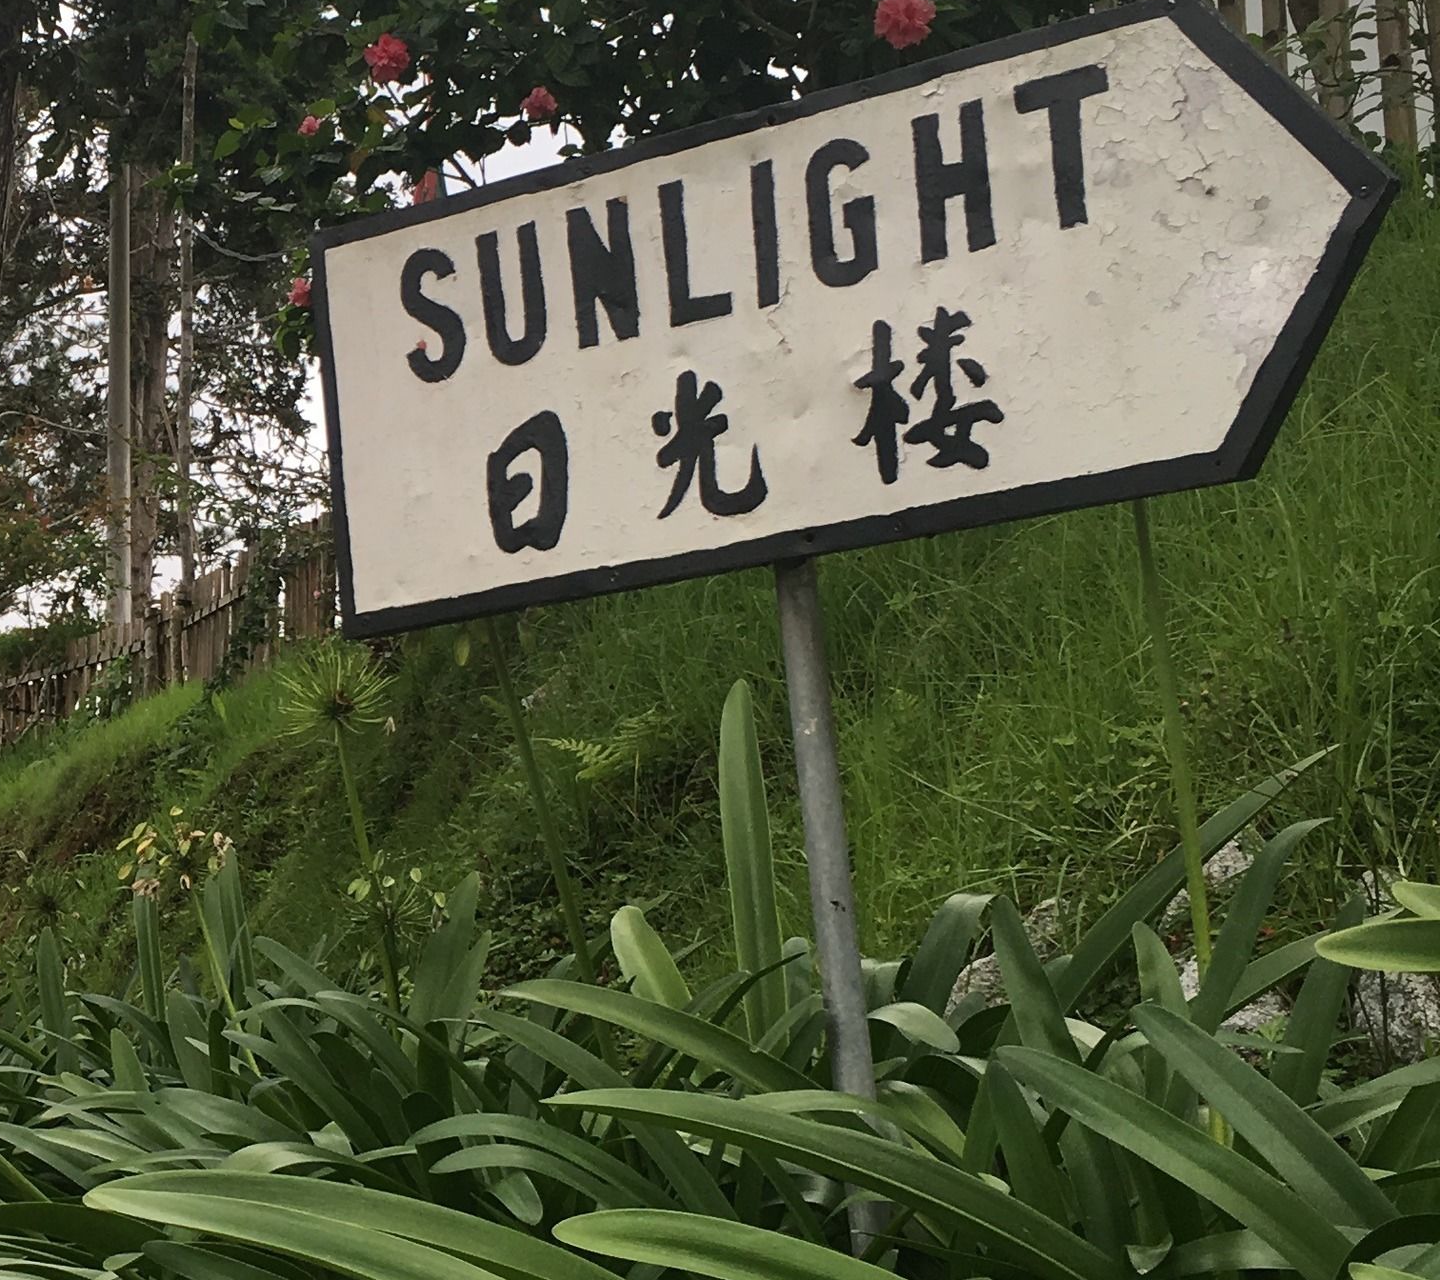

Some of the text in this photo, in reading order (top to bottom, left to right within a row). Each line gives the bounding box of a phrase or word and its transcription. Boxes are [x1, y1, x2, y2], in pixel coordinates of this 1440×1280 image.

[400, 64, 1108, 382] SUNLIGHT
[487, 306, 1005, 552] 日光楼
